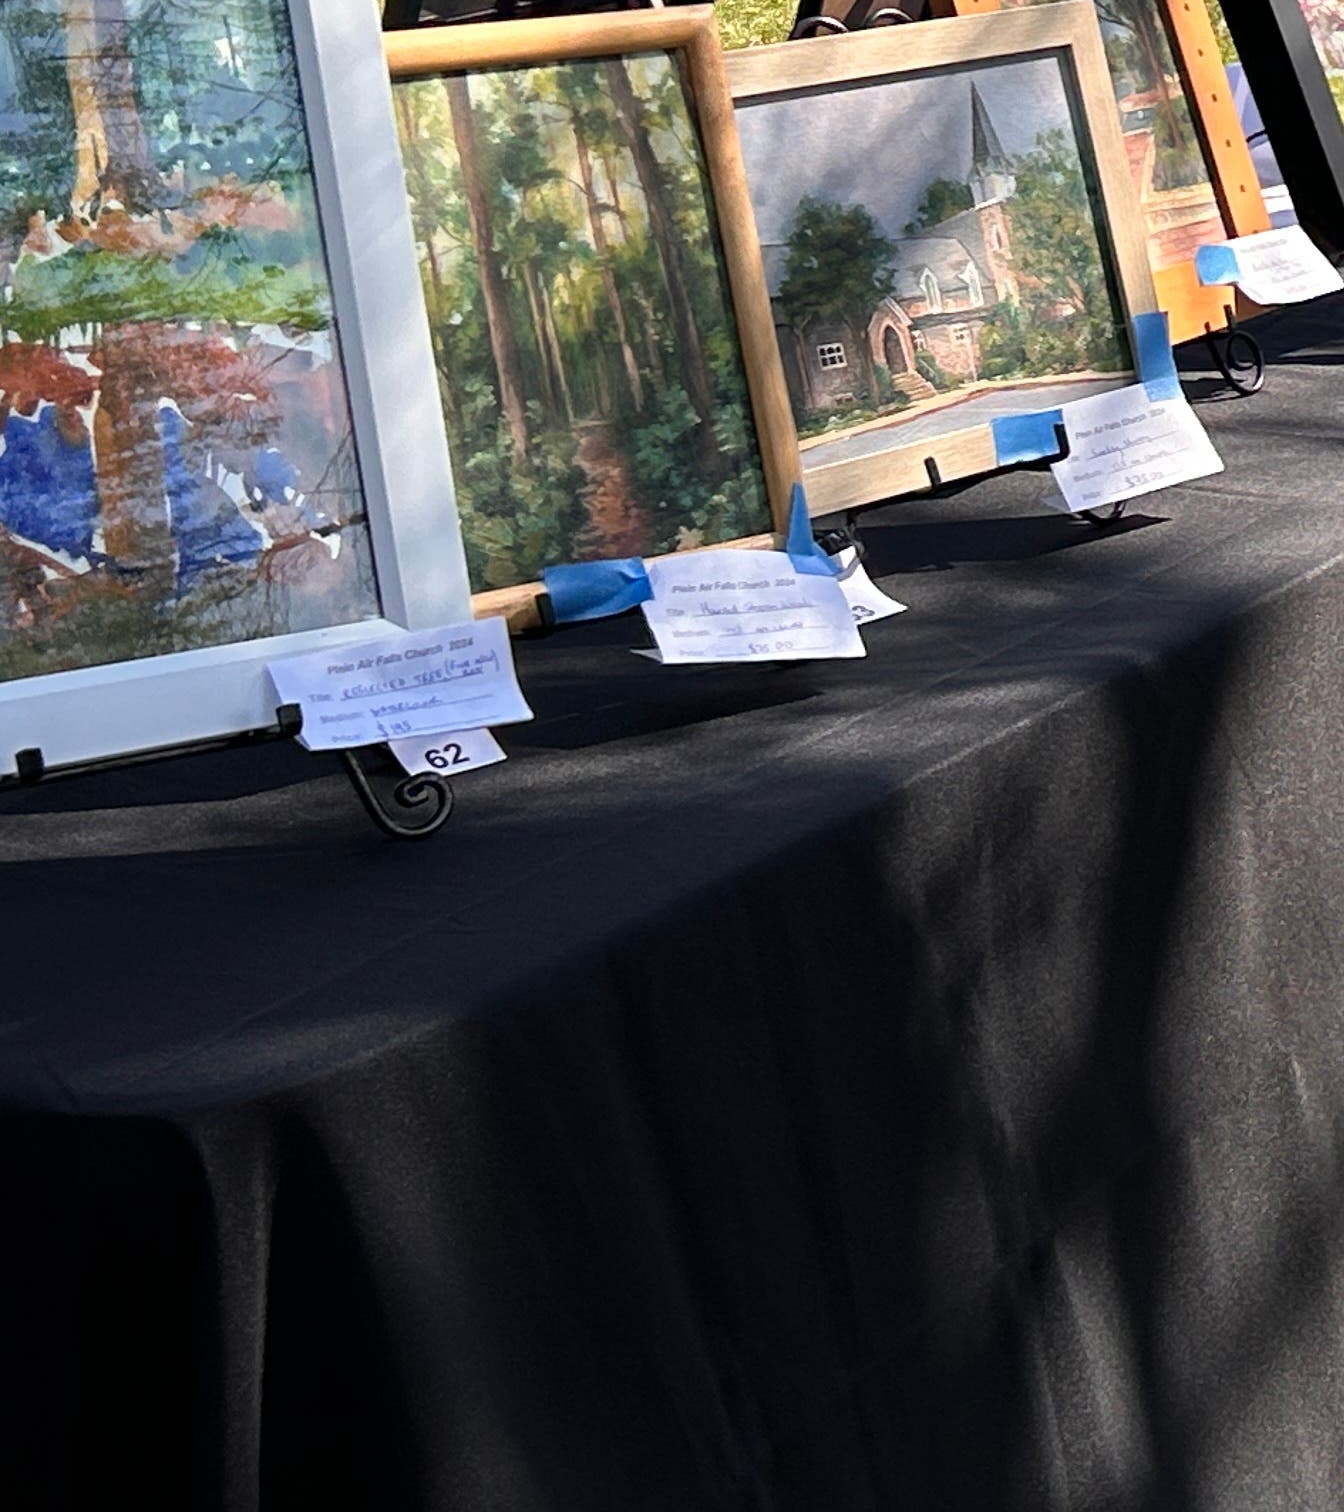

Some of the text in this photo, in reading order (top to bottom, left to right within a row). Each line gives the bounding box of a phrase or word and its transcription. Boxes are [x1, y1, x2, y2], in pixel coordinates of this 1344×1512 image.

[851, 605, 875, 622] 3
[356, 658, 374, 670] Air
[375, 653, 402, 666] Falls
[404, 644, 443, 660] Church
[448, 637, 473, 651] 2024
[424, 743, 471, 769] 62
